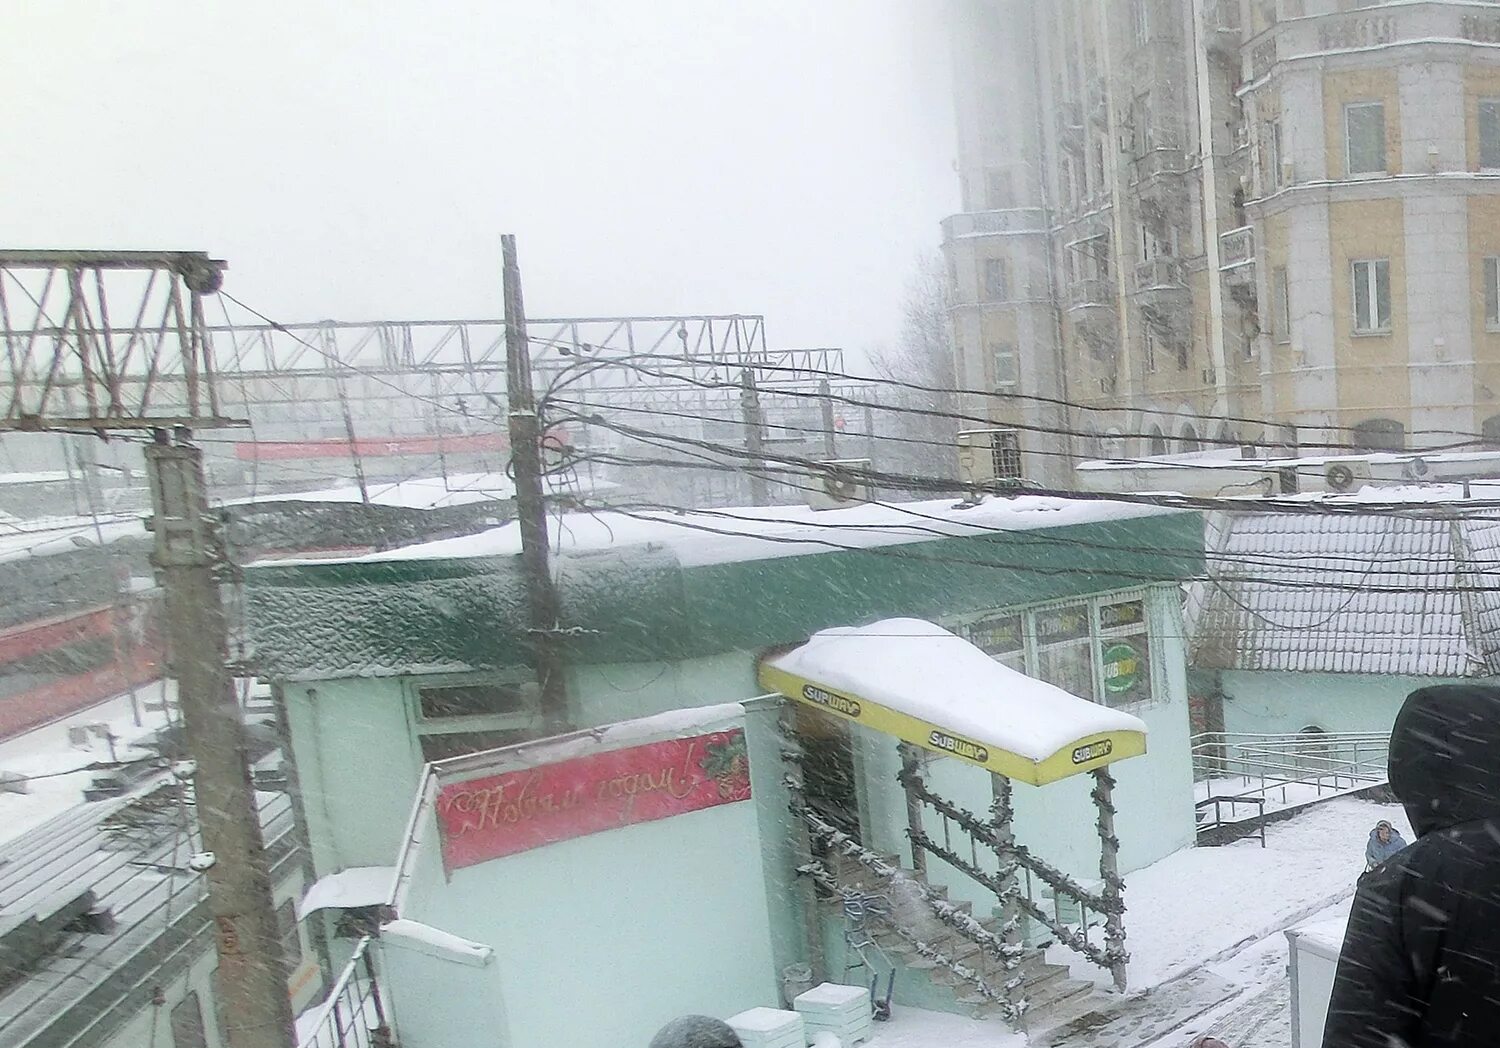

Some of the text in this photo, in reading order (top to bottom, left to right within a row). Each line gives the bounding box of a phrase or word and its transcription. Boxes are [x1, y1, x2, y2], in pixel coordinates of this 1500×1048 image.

[803, 686, 860, 716] SUBWAY
[931, 732, 985, 761] SUBWAY
[1073, 740, 1112, 763] SUBWAY
